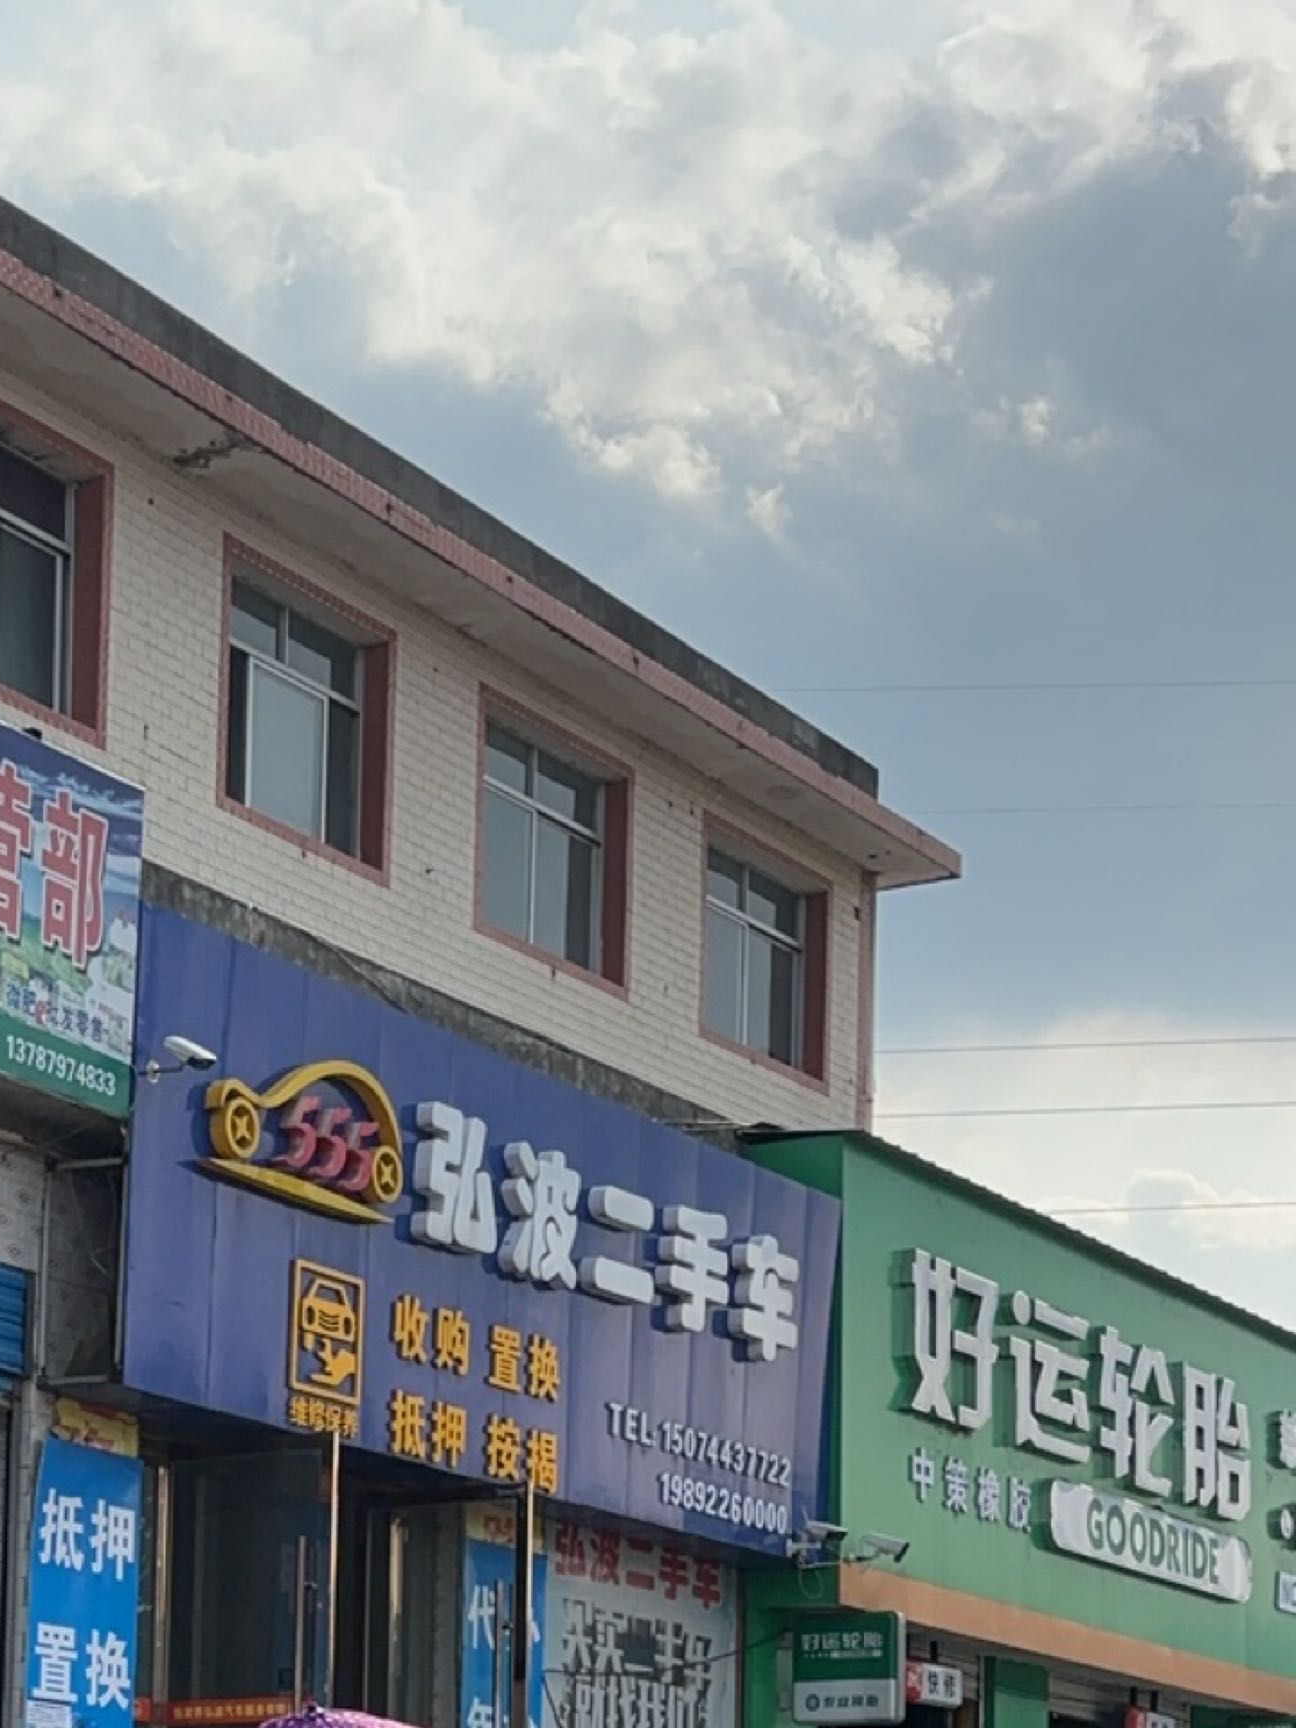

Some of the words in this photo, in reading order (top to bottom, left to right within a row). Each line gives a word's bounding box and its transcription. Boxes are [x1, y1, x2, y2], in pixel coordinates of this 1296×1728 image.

[7, 1035, 117, 1096] 13787974833
[414, 1100, 800, 1362] 弘波二手车
[392, 1293, 471, 1377] 收购
[484, 1323, 561, 1402] 置换
[910, 1247, 1252, 1522] 好运轮胎
[388, 1388, 468, 1469] 抵押
[484, 1411, 558, 1496] 按揭
[659, 1420, 792, 1488] 15074437722
[38, 1487, 137, 1581] 抵押
[657, 1472, 788, 1535] 19892260000
[909, 1446, 1032, 1534] 中策橡胶
[554, 1519, 722, 1609] 弘波二手车
[1087, 1498, 1221, 1587] GOODRIDE
[32, 1621, 131, 1711] 置换
